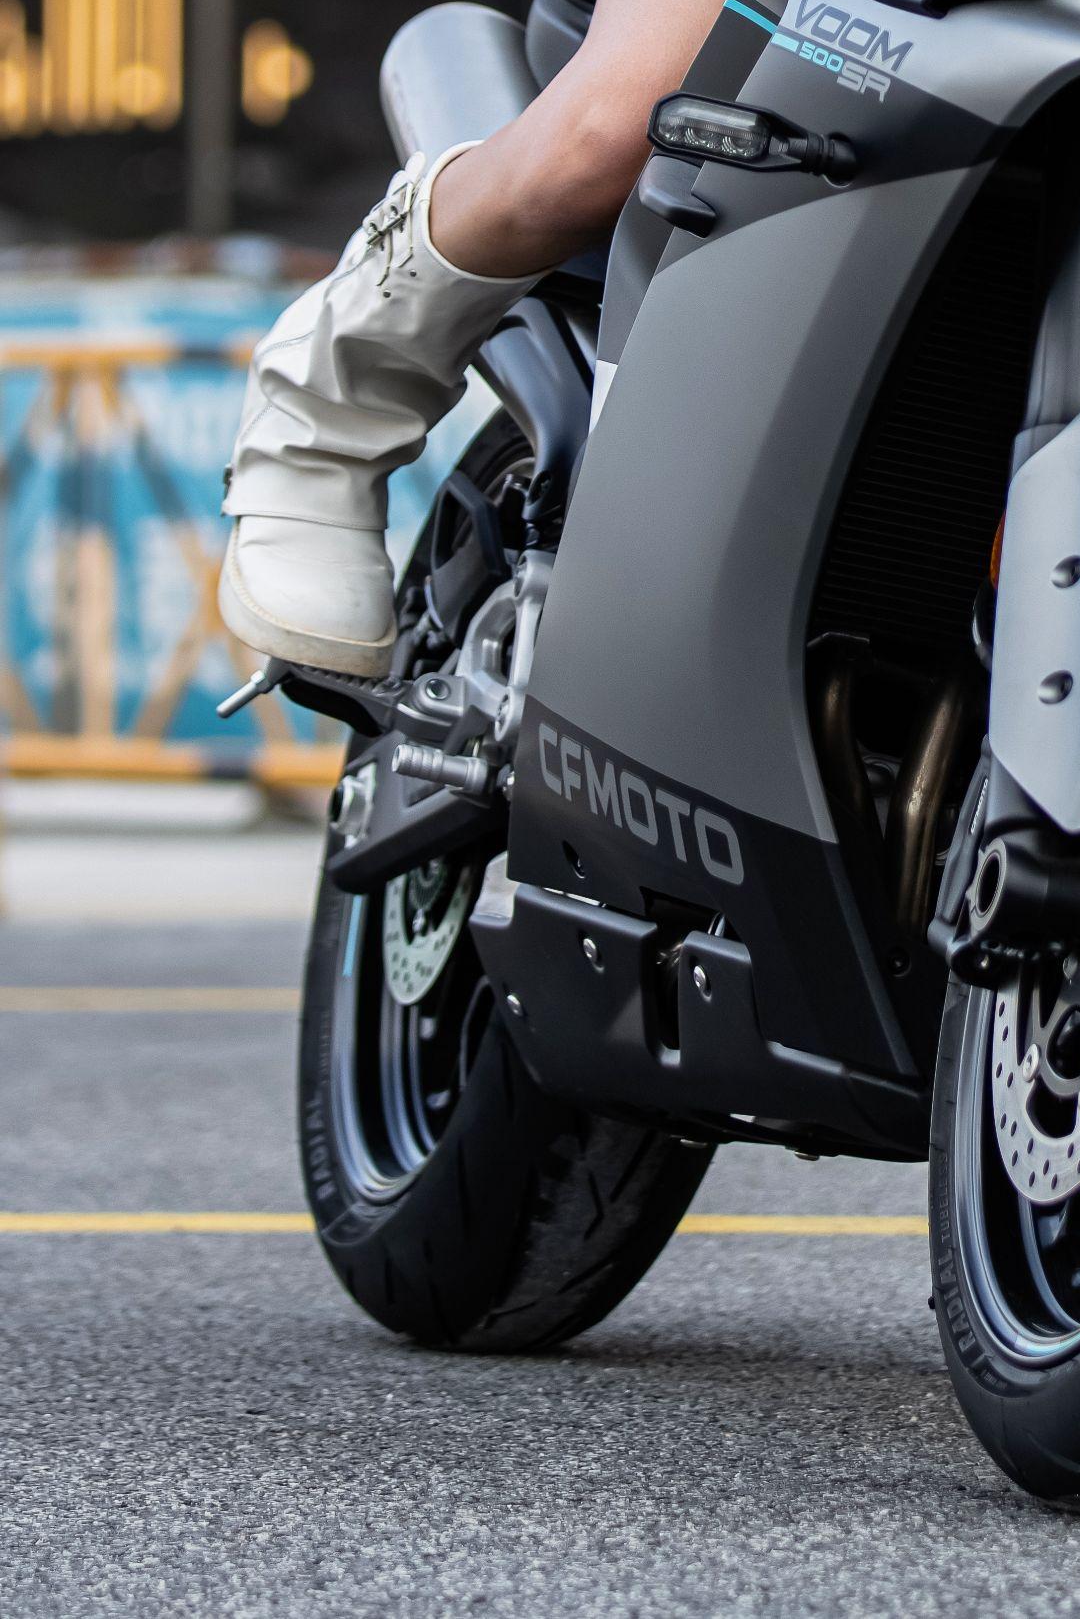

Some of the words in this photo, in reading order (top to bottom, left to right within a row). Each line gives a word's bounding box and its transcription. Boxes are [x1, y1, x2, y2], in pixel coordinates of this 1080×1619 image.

[538, 722, 745, 885] CFMOTO
[306, 1093, 335, 1200] RADIAL
[938, 1153, 952, 1245] TUBELESS
[939, 1249, 976, 1353] RADIAL
